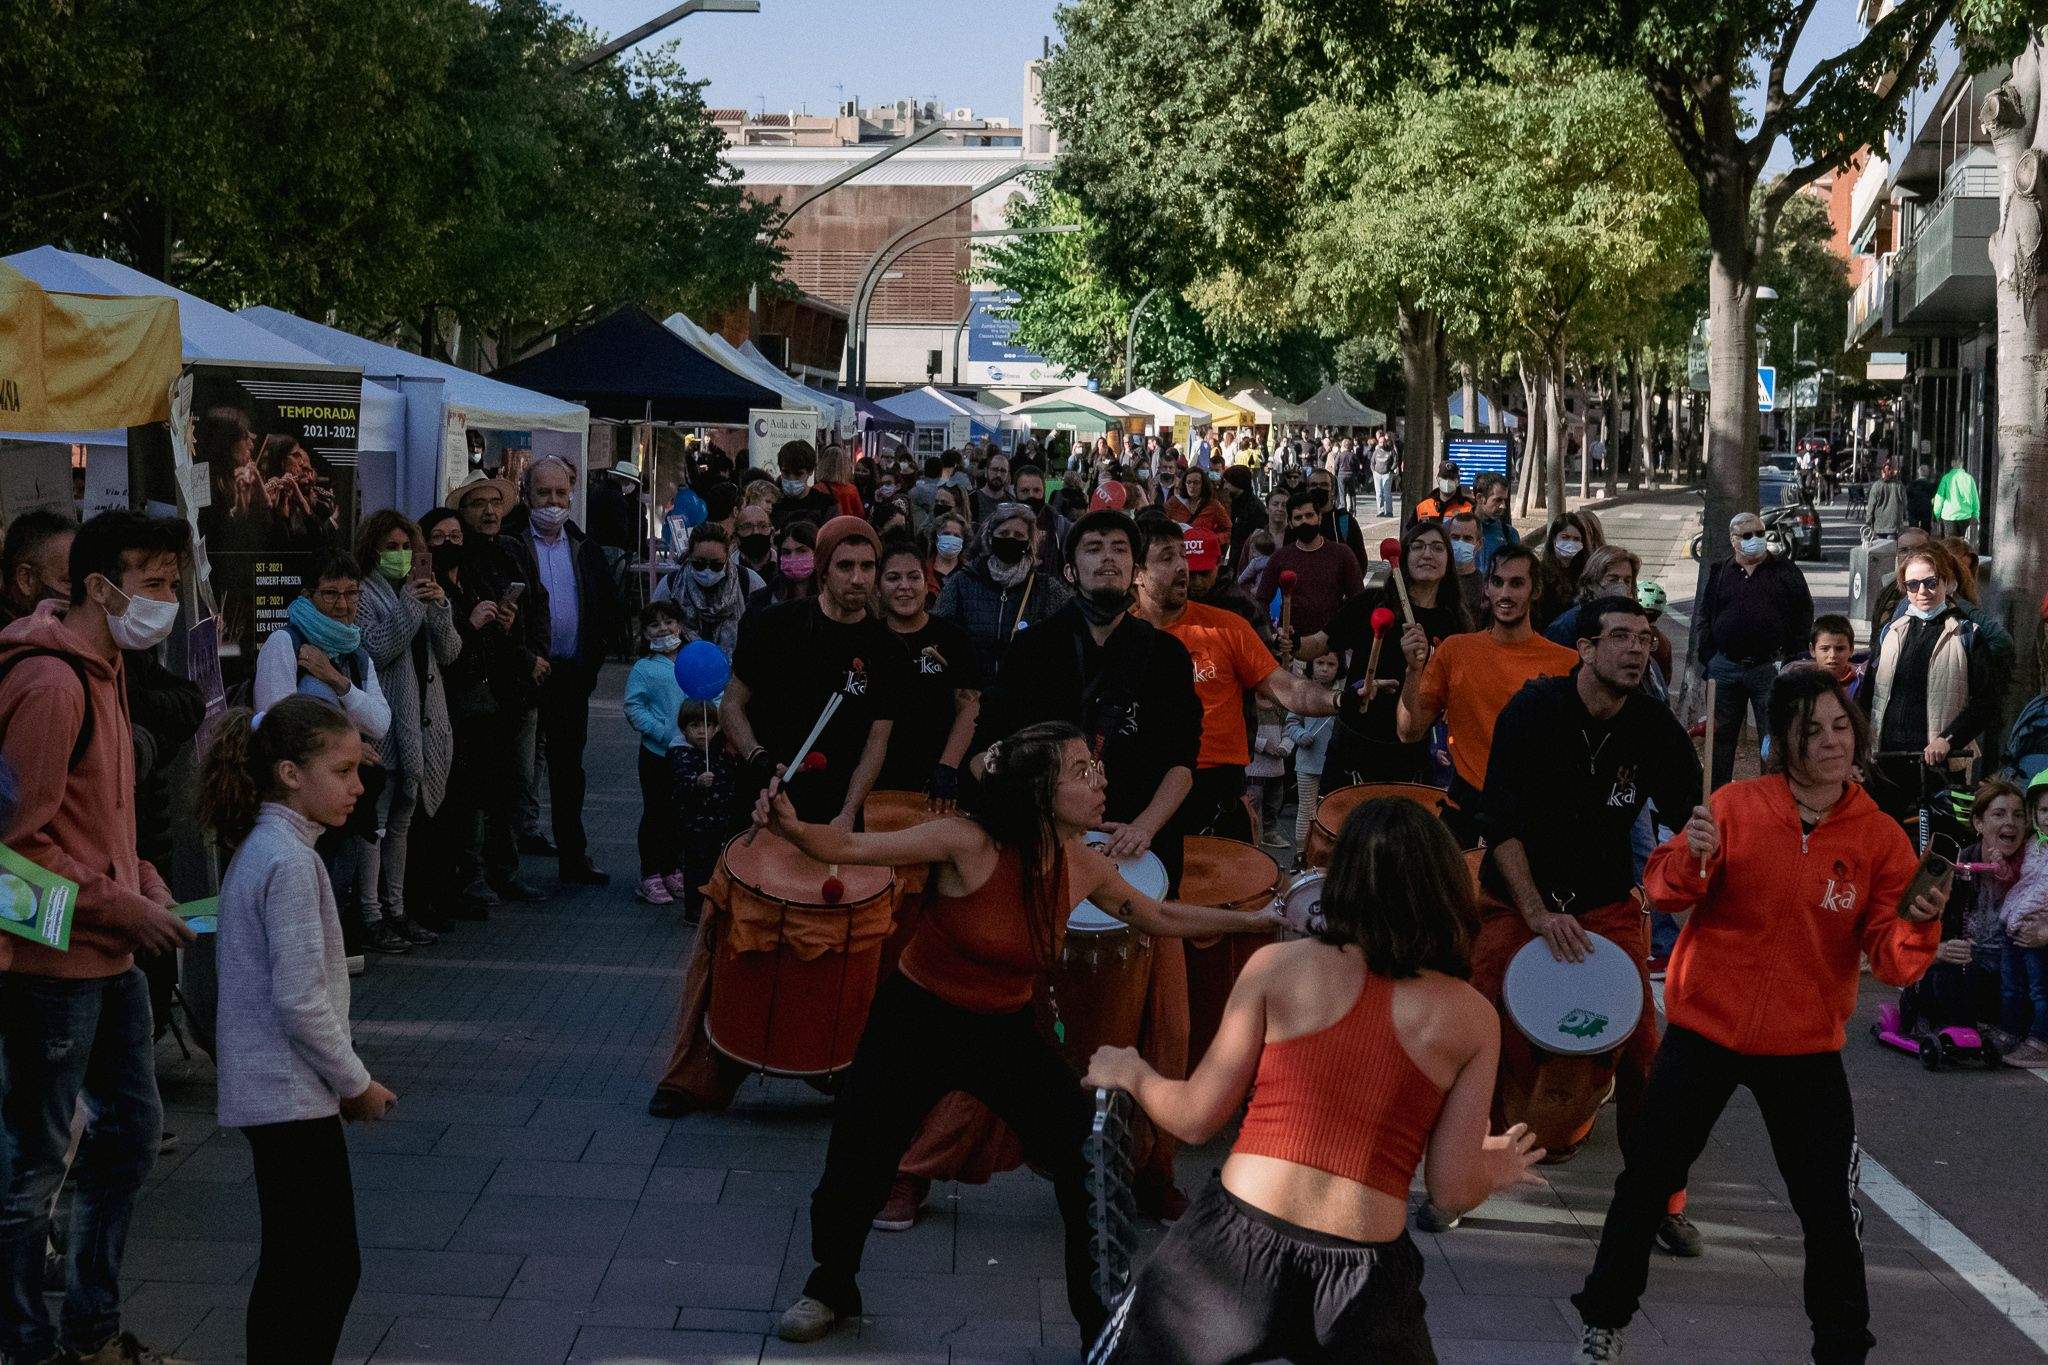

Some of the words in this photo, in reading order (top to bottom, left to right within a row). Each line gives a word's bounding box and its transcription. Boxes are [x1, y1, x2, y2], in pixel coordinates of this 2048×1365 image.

[278, 405, 356, 420] TEMPORADA
[770, 419, 788, 429] Aula
[790, 419, 799, 429] de
[303, 425, 356, 439] 2021-2022
[269, 563, 283, 572] 2021
[270, 596, 284, 605] 2021
